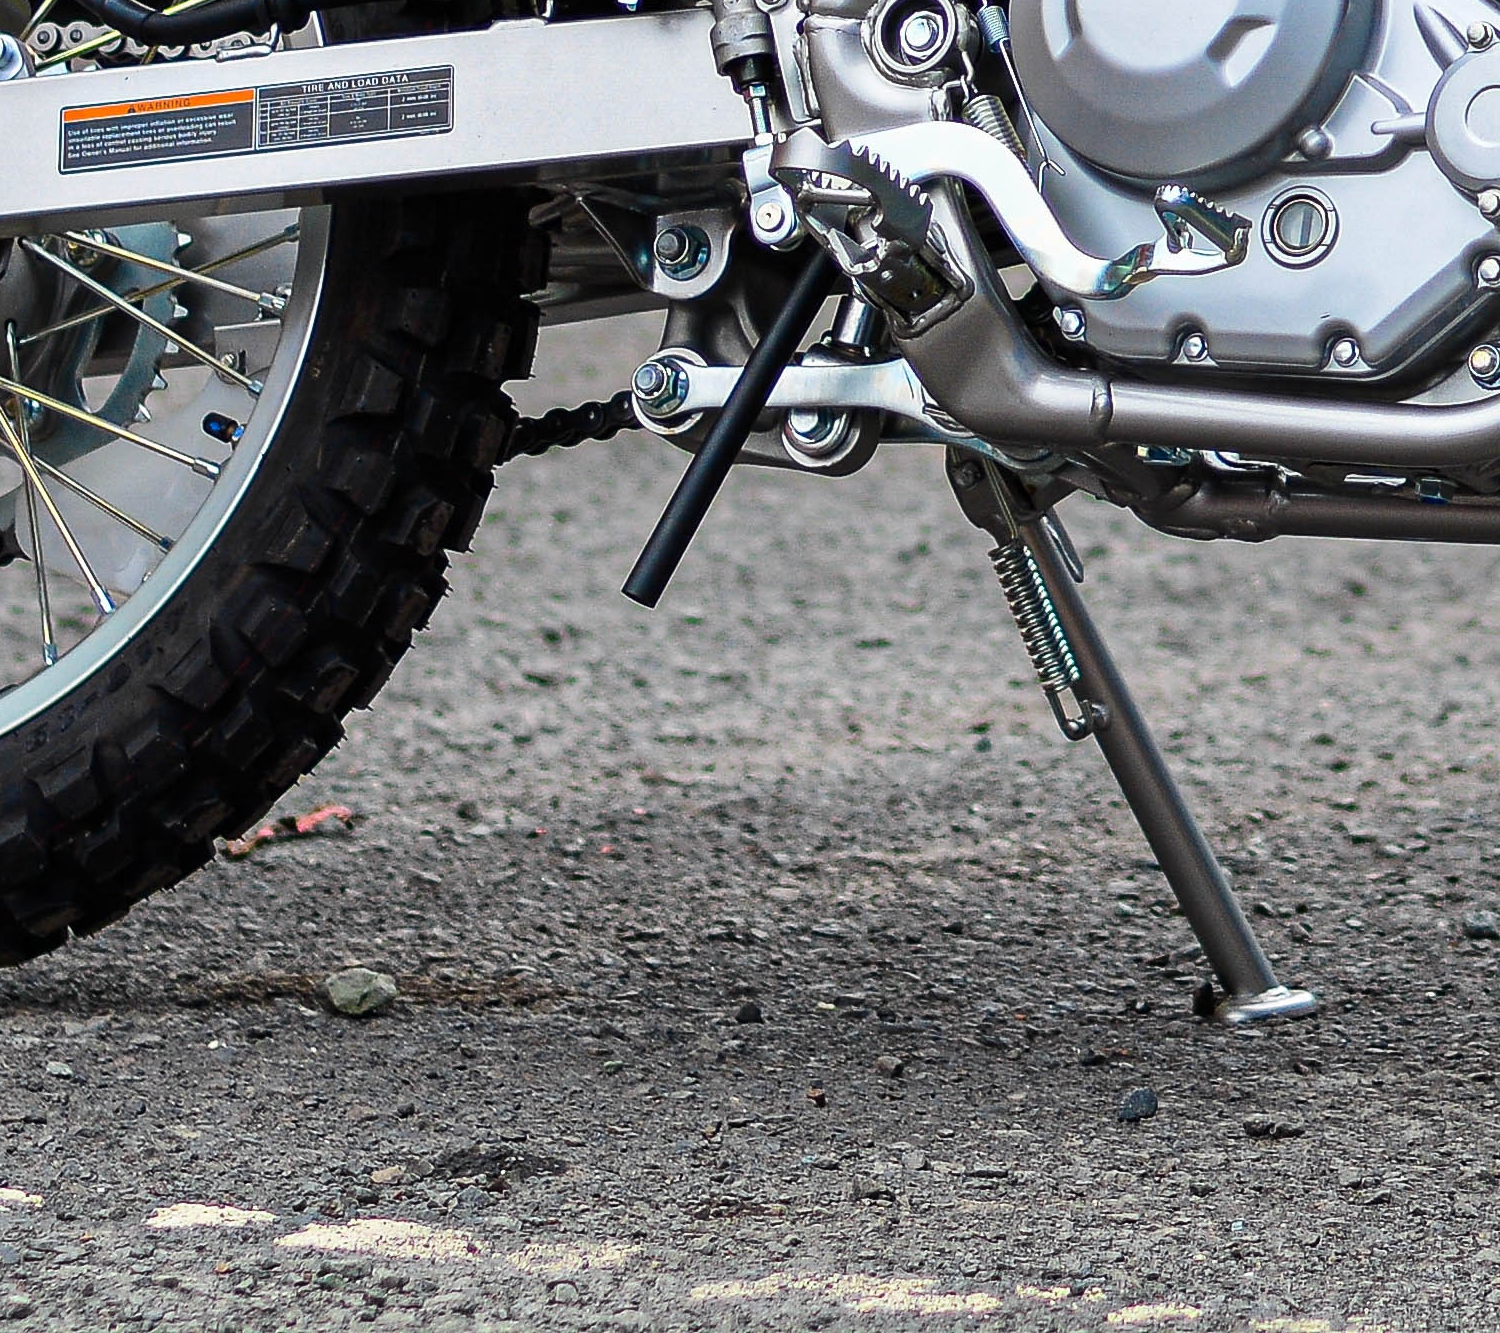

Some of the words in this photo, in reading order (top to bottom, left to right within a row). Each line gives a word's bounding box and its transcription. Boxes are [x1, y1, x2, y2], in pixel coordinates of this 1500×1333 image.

[302, 83, 324, 93] TIRE
[327, 81, 348, 90] AND
[351, 78, 378, 87] LOAD
[381, 74, 408, 84] DATA
[137, 98, 190, 111] WARNING
